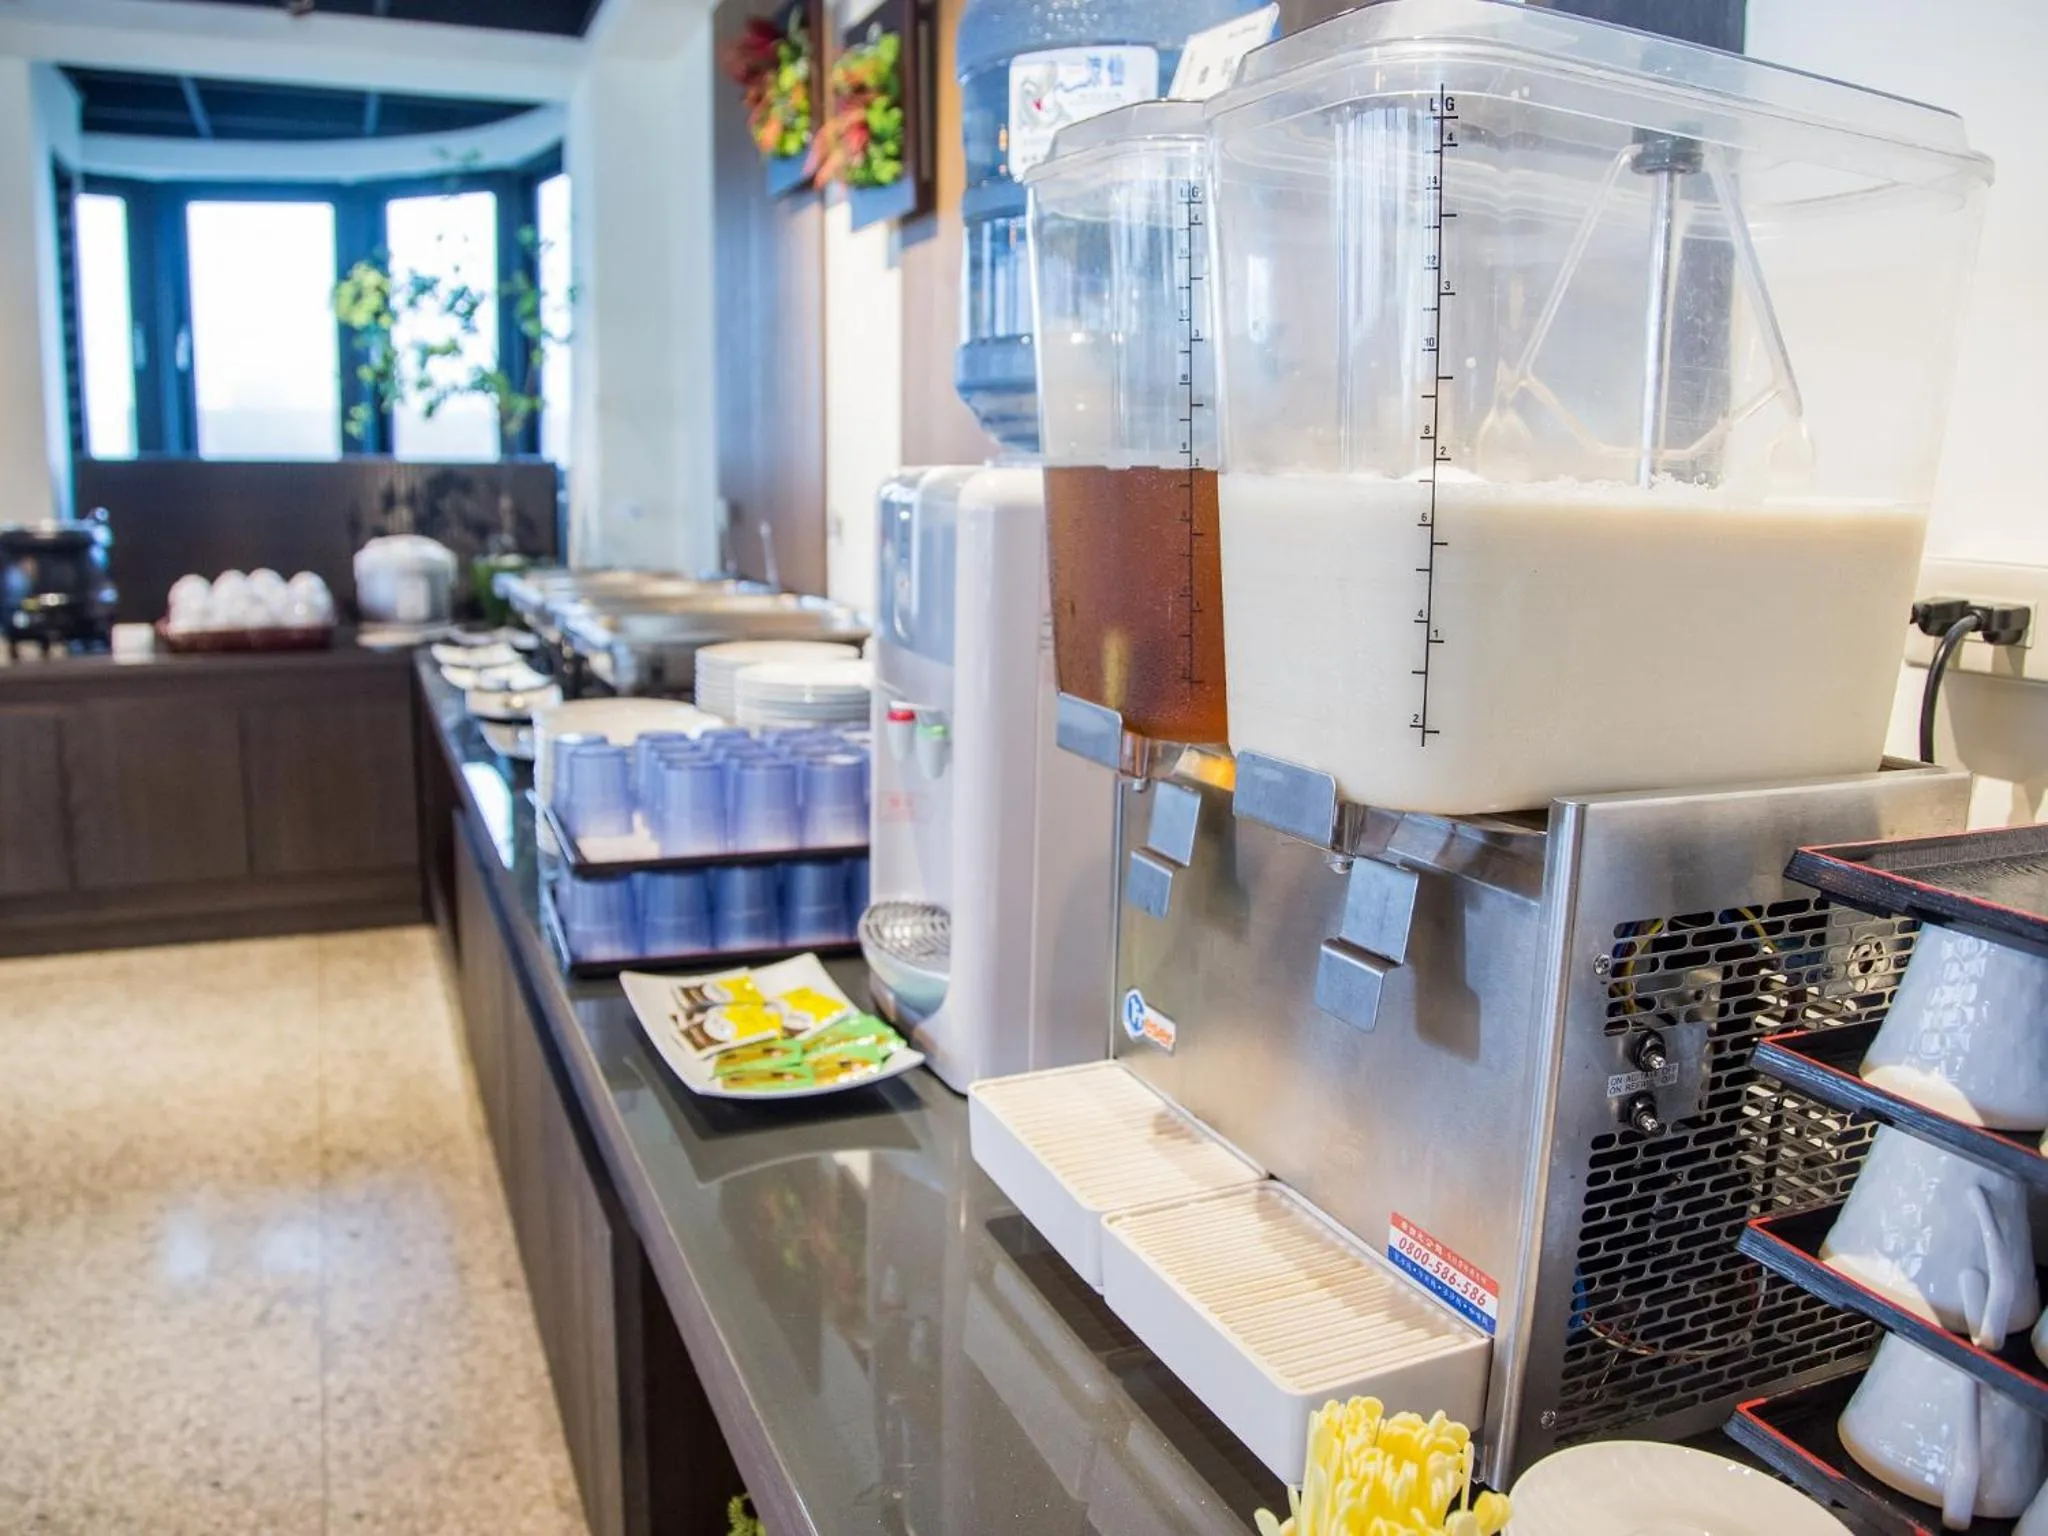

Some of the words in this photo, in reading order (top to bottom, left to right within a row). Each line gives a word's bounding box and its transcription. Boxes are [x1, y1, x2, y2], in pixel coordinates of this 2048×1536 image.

[1445, 96, 1455, 112] G
[1446, 132, 1454, 142] 4
[1425, 255, 1437, 265] 12
[1444, 280, 1451, 290] 3
[1424, 336, 1435, 347] 10
[1423, 425, 1431, 435] 8
[1439, 446, 1447, 456] 2
[1421, 512, 1428, 522] 6
[1417, 609, 1424, 618] 4
[1412, 713, 1420, 723] 2
[1610, 1076, 1623, 1086] ON
[1609, 1086, 1622, 1095] ON
[1398, 1236, 1488, 1307] 0800-586-586
